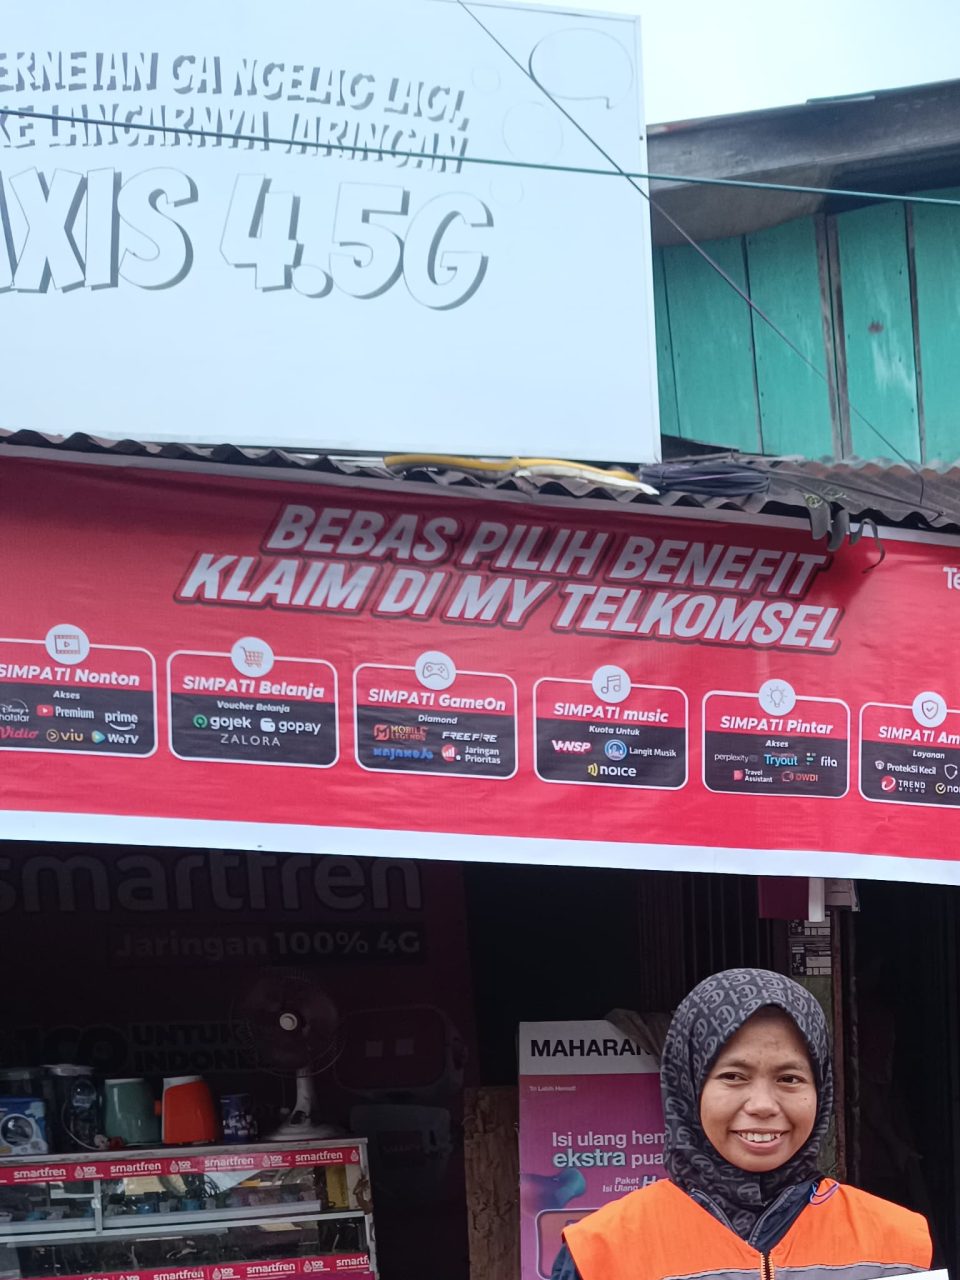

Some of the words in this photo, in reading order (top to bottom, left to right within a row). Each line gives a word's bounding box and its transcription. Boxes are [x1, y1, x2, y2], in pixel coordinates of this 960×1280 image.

[0, 166, 199, 294] XIS
[219, 173, 494, 312] 4.5G
[265, 503, 460, 562] BEBAS
[459, 520, 608, 576] PILIH
[608, 535, 827, 596] BENEFIT
[180, 553, 377, 610] KLAIM
[377, 567, 446, 616] DI
[446, 574, 552, 624] MY
[555, 583, 839, 649] TELKOMSEL
[75, 669, 140, 686] Nonton
[182, 675, 255, 693] SIMPATI
[259, 681, 325, 699] Belanja
[53, 690, 81, 700] Akses
[368, 688, 435, 706] SIMPATI
[438, 694, 506, 711] GameOn
[55, 706, 95, 719] Premium
[217, 700, 254, 711] Voucher
[256, 703, 290, 713] Belanja
[553, 703, 620, 719] SIMPATI
[623, 709, 669, 723] music
[105, 711, 138, 723] prime
[210, 716, 252, 730] gojek
[418, 714, 458, 725] Diamond
[278, 721, 322, 735] gopay
[589, 725, 614, 734] Kuota
[616, 727, 640, 736] Untuk
[720, 715, 783, 731] SIMPATI
[786, 720, 833, 735] Pintar
[60, 729, 84, 742] viu
[107, 733, 139, 744] WeTV
[220, 733, 281, 746] ZALORA
[878, 726, 934, 742] SIMPATI
[765, 739, 789, 748] Akses
[465, 745, 500, 756] Jaringan
[629, 746, 653, 757] Langit
[654, 748, 677, 757] Musik
[912, 750, 945, 760] Layanan
[465, 754, 501, 764] Prioritas
[714, 753, 749, 764] perplexity
[764, 754, 798, 767] Tryout
[599, 765, 637, 777] noice
[919, 765, 937, 775] Kecil
[745, 775, 773, 783] Assistant
[898, 780, 926, 789] TREND
[115, 931, 268, 961] Jaringan
[273, 930, 370, 955] 100%
[377, 930, 421, 955] 4G
[552, 1132, 572, 1147] Isi
[577, 1131, 627, 1149] ulang
[13, 1167, 66, 1179] smartfren
[110, 1161, 162, 1173] smartfren
[204, 1156, 254, 1167] smartfren
[295, 1150, 343, 1161] smartfren
[553, 1148, 626, 1168] ekstra
[615, 1177, 639, 1185] Paket
[246, 1262, 295, 1274] smartfren
